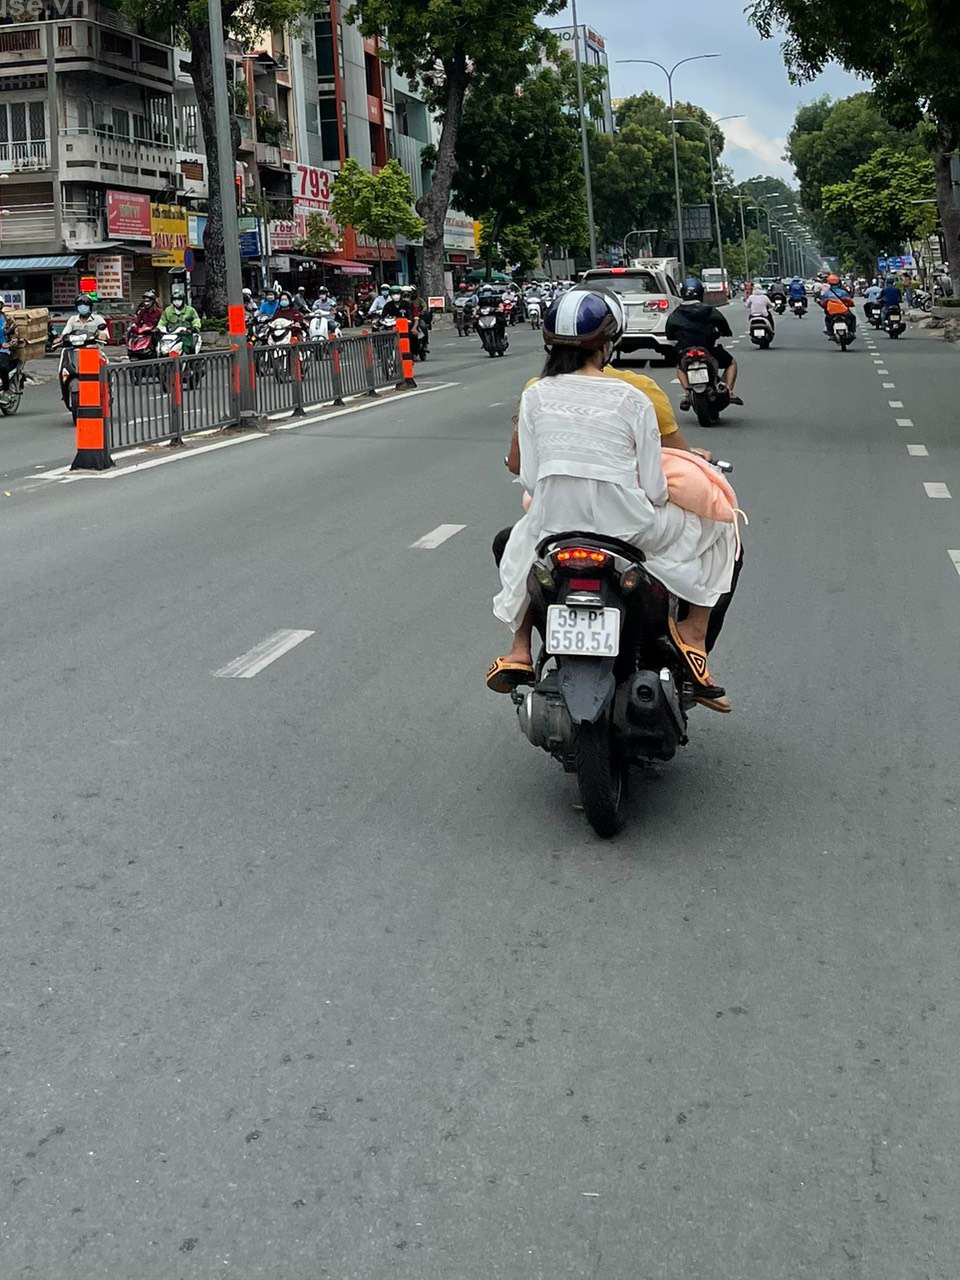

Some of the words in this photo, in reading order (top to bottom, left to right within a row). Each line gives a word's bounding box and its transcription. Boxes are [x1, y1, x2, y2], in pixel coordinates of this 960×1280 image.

[297, 166, 330, 199] 793
[558, 609, 605, 630] 59-P1
[551, 630, 613, 655] 558.54
